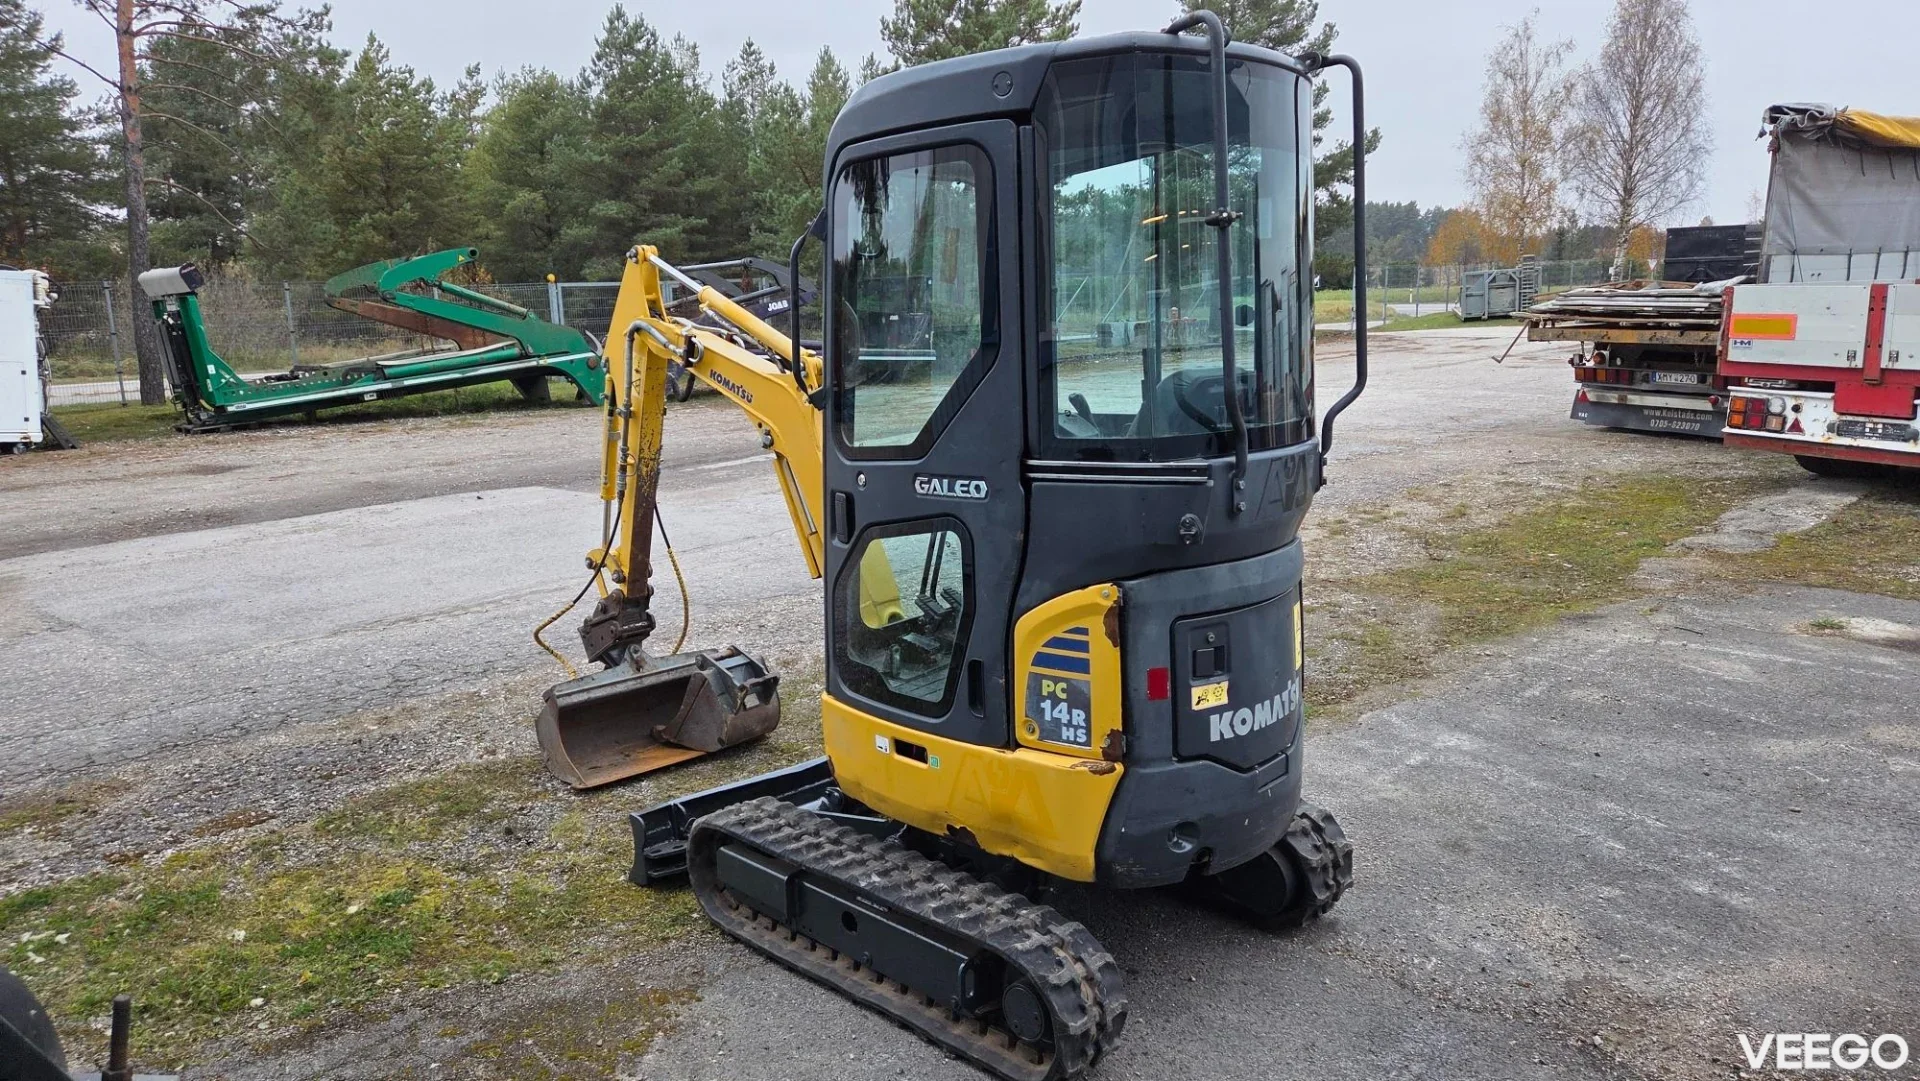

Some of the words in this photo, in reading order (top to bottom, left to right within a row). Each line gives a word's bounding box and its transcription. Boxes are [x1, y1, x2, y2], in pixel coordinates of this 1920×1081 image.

[768, 300, 788, 311] JOAB
[709, 369, 753, 403] KOMATSU
[914, 477, 988, 498] GALEO
[1041, 680, 1068, 699] PC
[1061, 727, 1087, 743] HS
